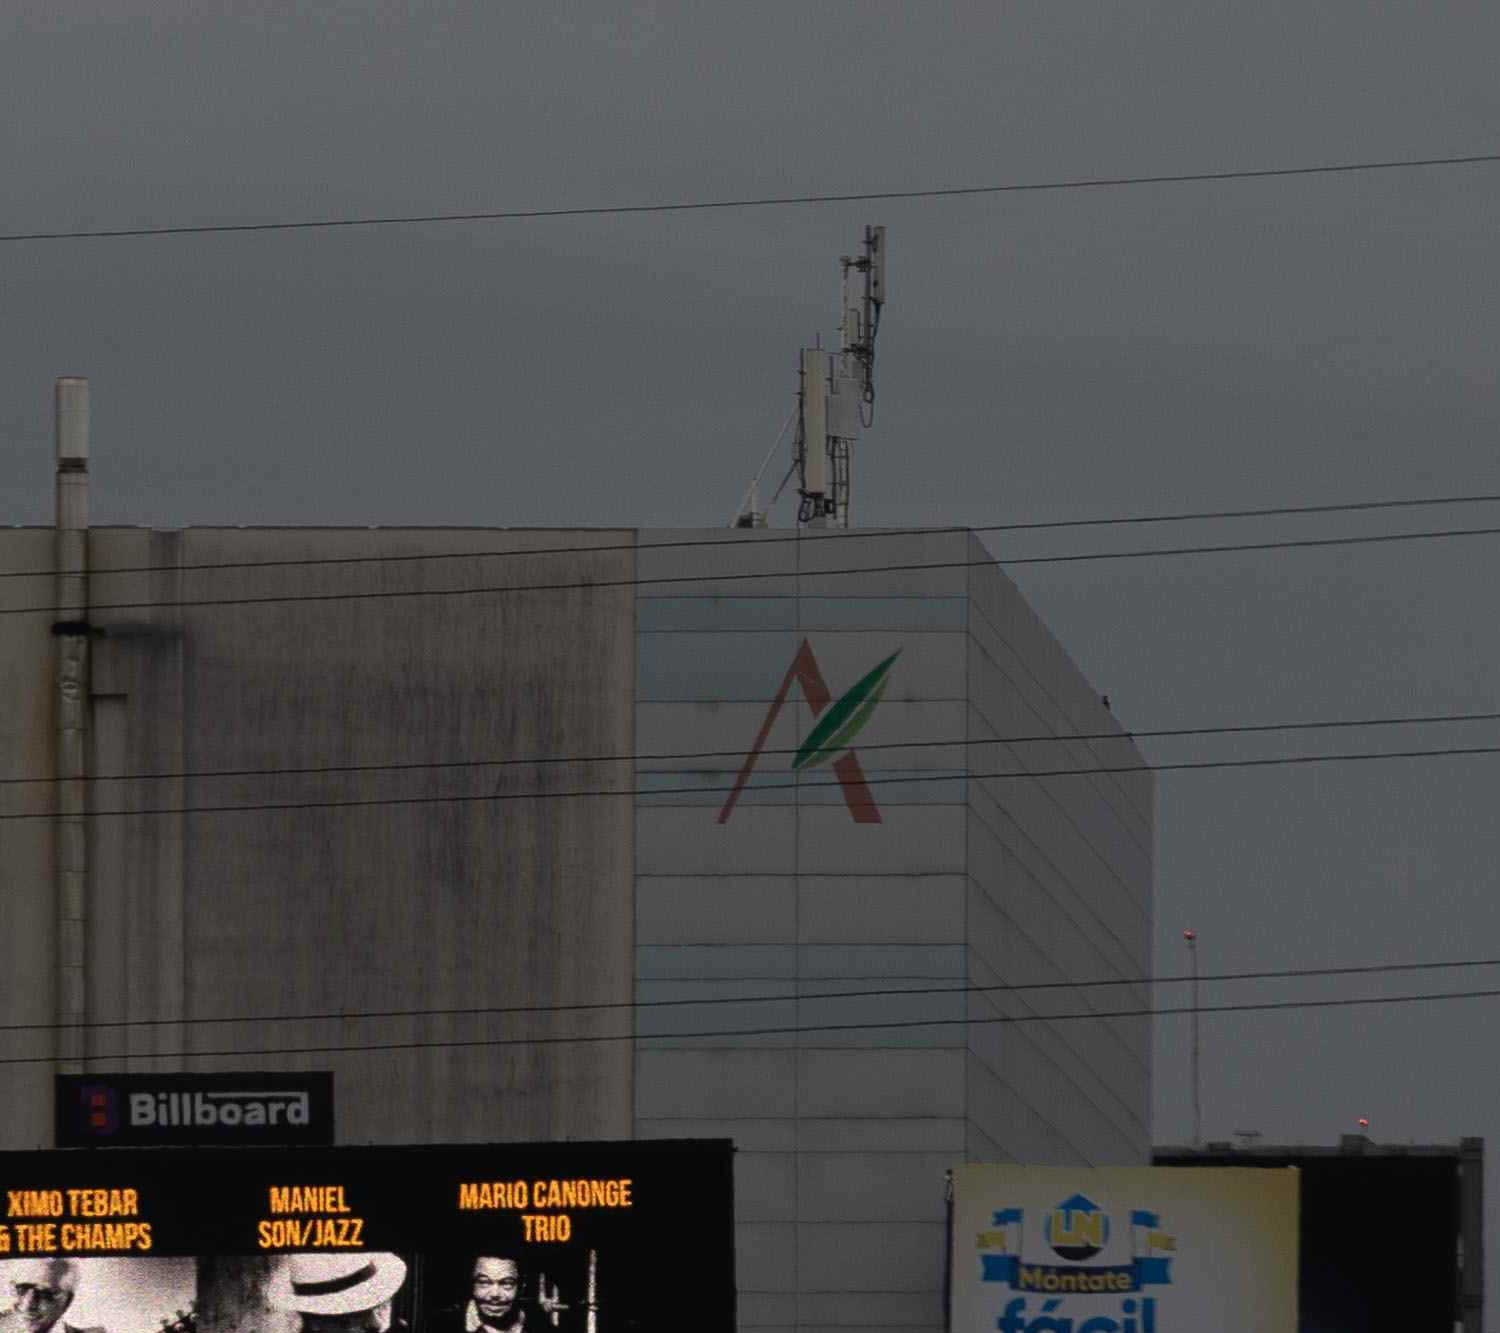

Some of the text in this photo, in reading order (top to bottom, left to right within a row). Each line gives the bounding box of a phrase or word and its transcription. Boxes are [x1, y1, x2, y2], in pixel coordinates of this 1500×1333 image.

[130, 1092, 309, 1126] Billboard
[7, 1189, 138, 1217] XIMO TEBAR
[269, 1186, 351, 1214] MANIEL
[459, 1179, 633, 1210] MARIO CANONGE
[16, 1224, 57, 1251] THE
[61, 1222, 153, 1250] CHAMPS
[258, 1218, 364, 1247] SON/JAZZ
[522, 1214, 571, 1242] TRIO
[1019, 1266, 1132, 1291] Móntate
